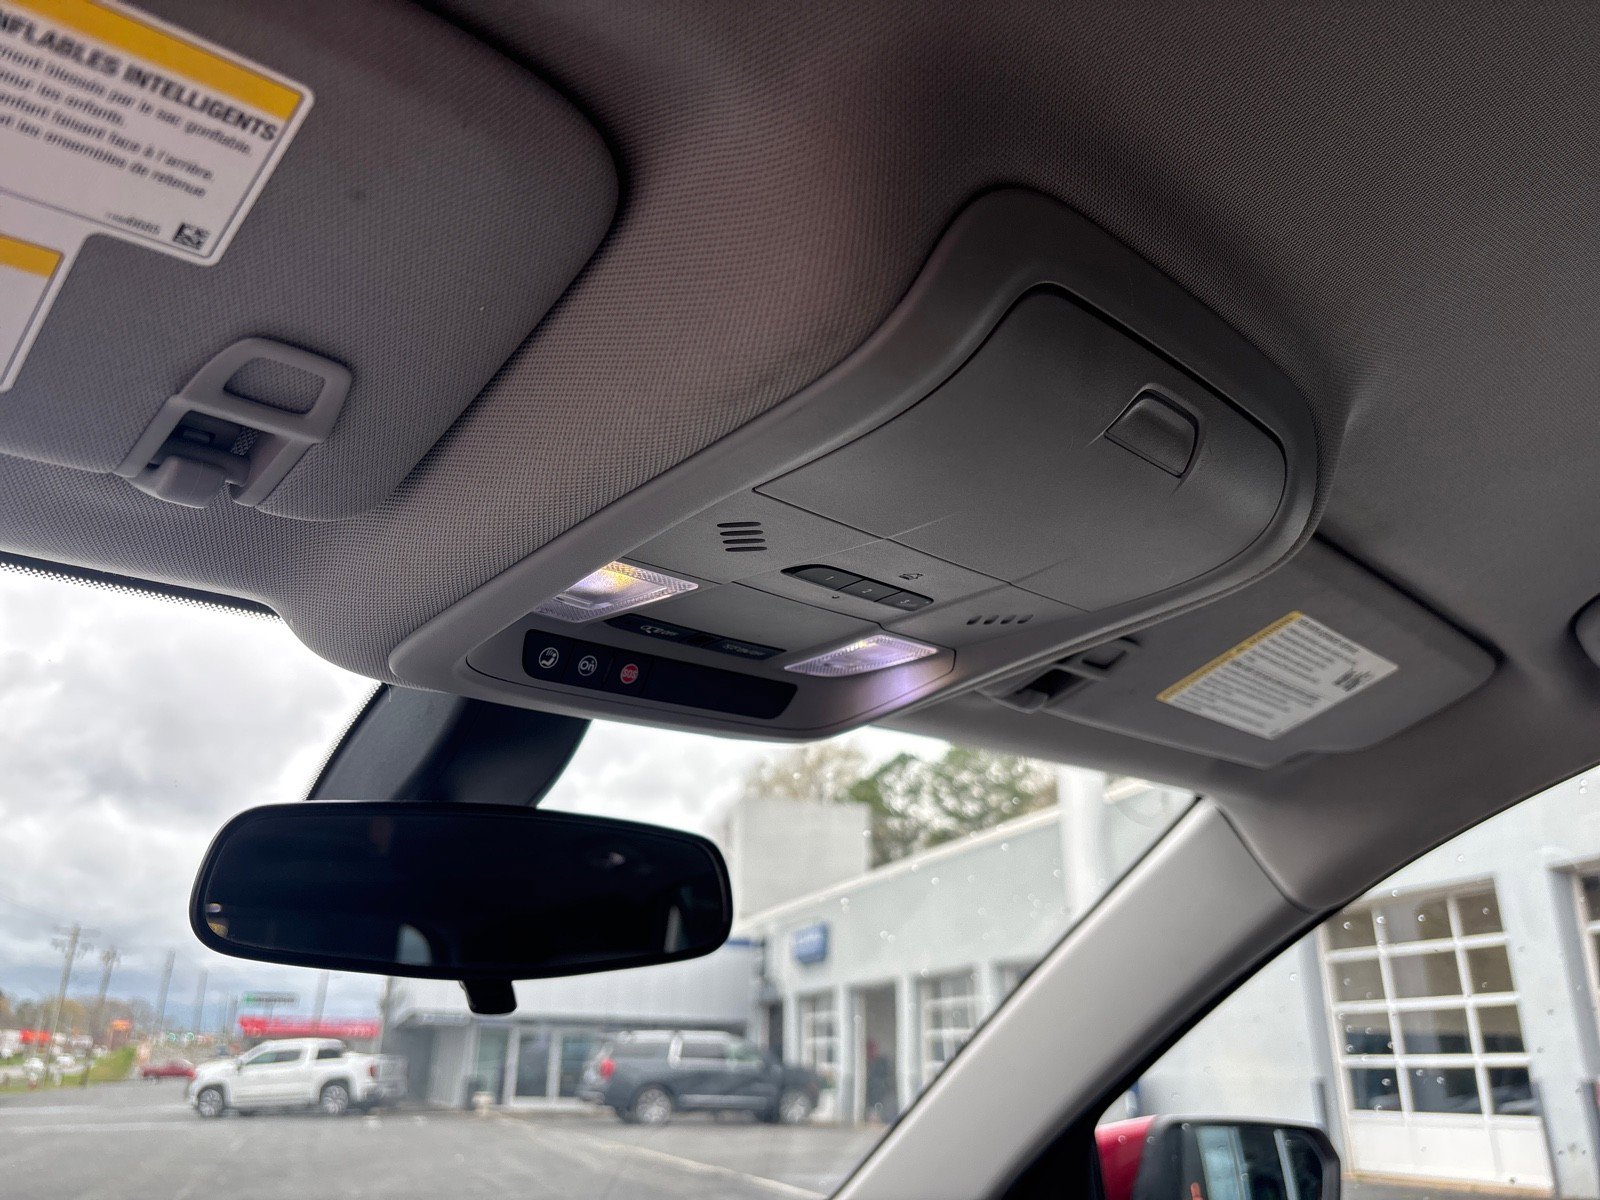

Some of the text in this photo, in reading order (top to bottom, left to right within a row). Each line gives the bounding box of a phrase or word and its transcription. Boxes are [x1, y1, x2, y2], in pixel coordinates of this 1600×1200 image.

[122, 63, 278, 142] INTELLIGENTS
[580, 660, 596, 673] On
[622, 667, 639, 680] SOS
